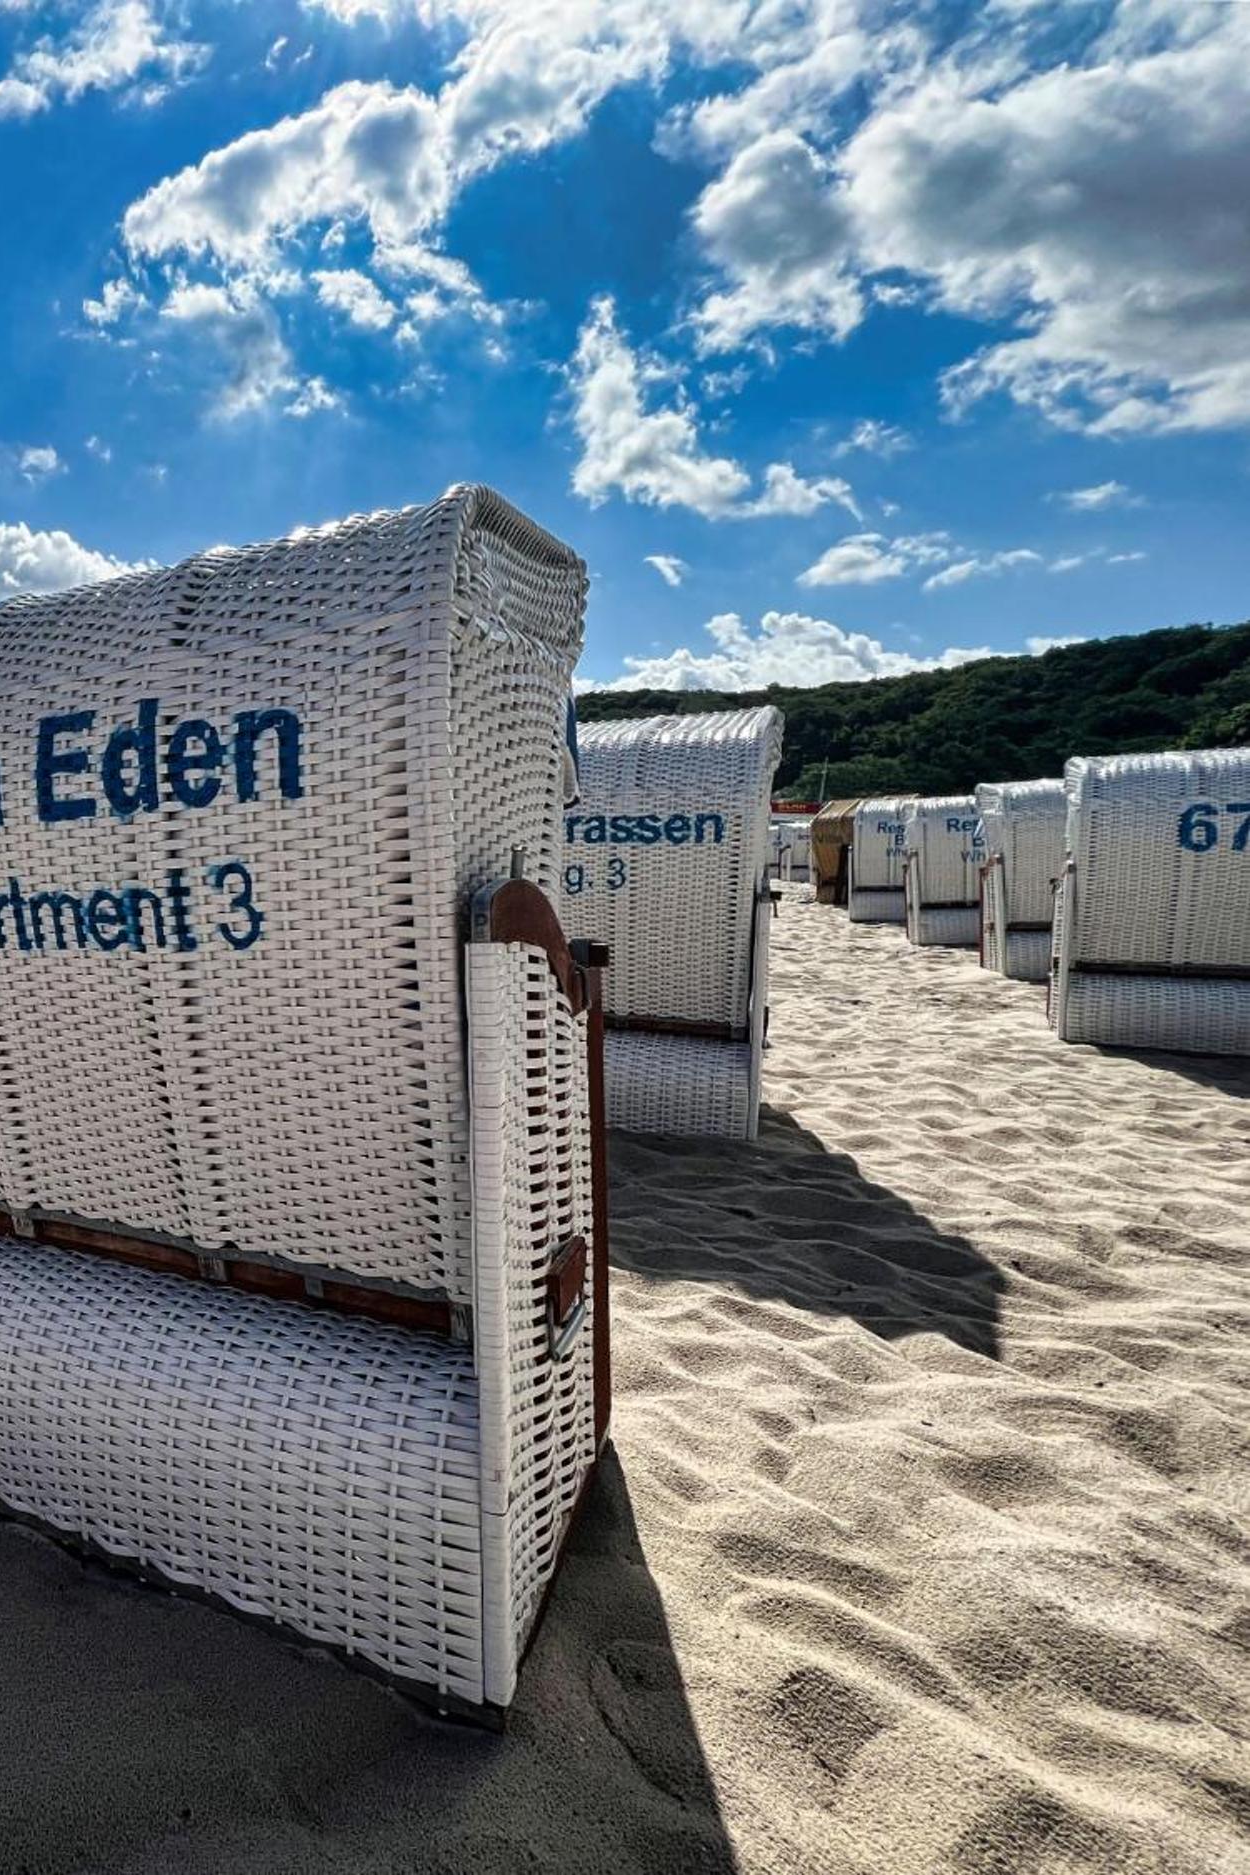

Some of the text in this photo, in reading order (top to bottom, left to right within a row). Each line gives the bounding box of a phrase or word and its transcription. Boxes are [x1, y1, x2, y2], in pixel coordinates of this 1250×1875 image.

[34, 697, 304, 822] Eden
[564, 813, 726, 843] rassen
[876, 821, 906, 834] Res
[564, 858, 627, 895] g. 3
[211, 858, 264, 951] 3
